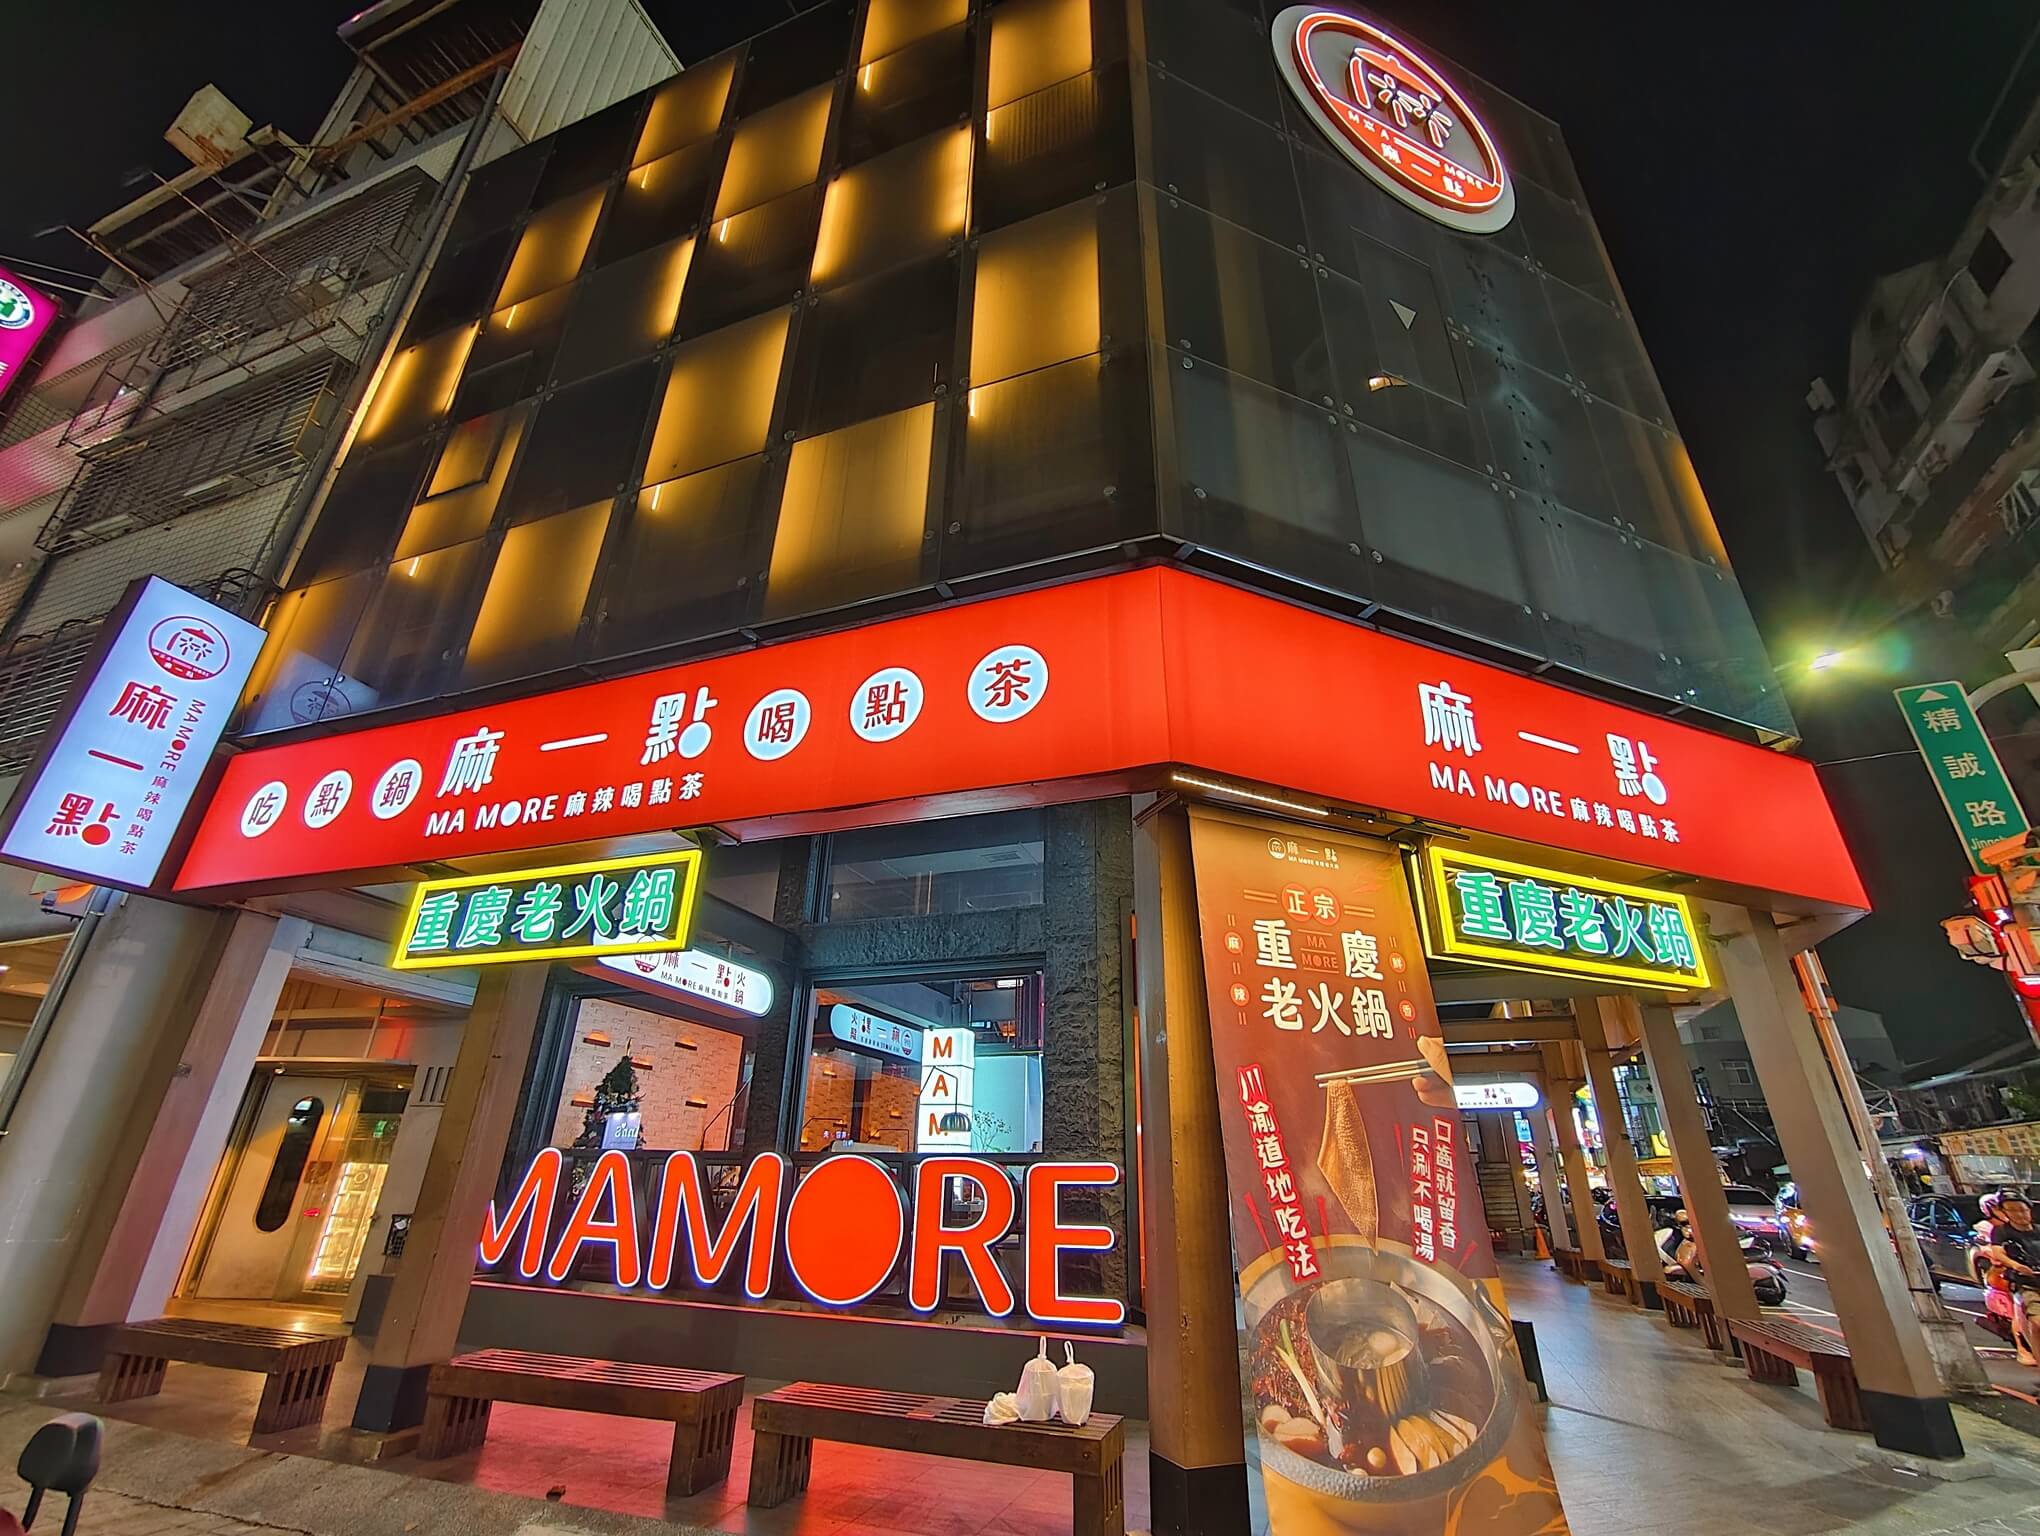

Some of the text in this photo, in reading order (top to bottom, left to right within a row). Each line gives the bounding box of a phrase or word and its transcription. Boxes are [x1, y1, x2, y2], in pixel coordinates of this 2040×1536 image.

[44, 680, 178, 846] 麻一點
[437, 686, 718, 799] 麻一點
[1417, 680, 1668, 806] 麻一點
[1921, 707, 2008, 828] 精誠路
[424, 772, 705, 837] MA MORE 麻辣喝點茶
[1428, 761, 1681, 844] MA MORE 麻辣喝點茶
[407, 868, 676, 951] 重慶老火鍋
[1285, 888, 1336, 920] 正宗
[1306, 935, 1327, 949] MA
[1454, 871, 1697, 970] 重慶老火鍋
[1260, 976, 1394, 1040] 老火鍋
[1301, 953, 1339, 969] MORE
[1238, 1067, 1318, 1278] 川渝道地吃法
[1411, 1126, 1435, 1262] 只涮不喝湯
[1433, 1118, 1457, 1249] 口齒就留香
